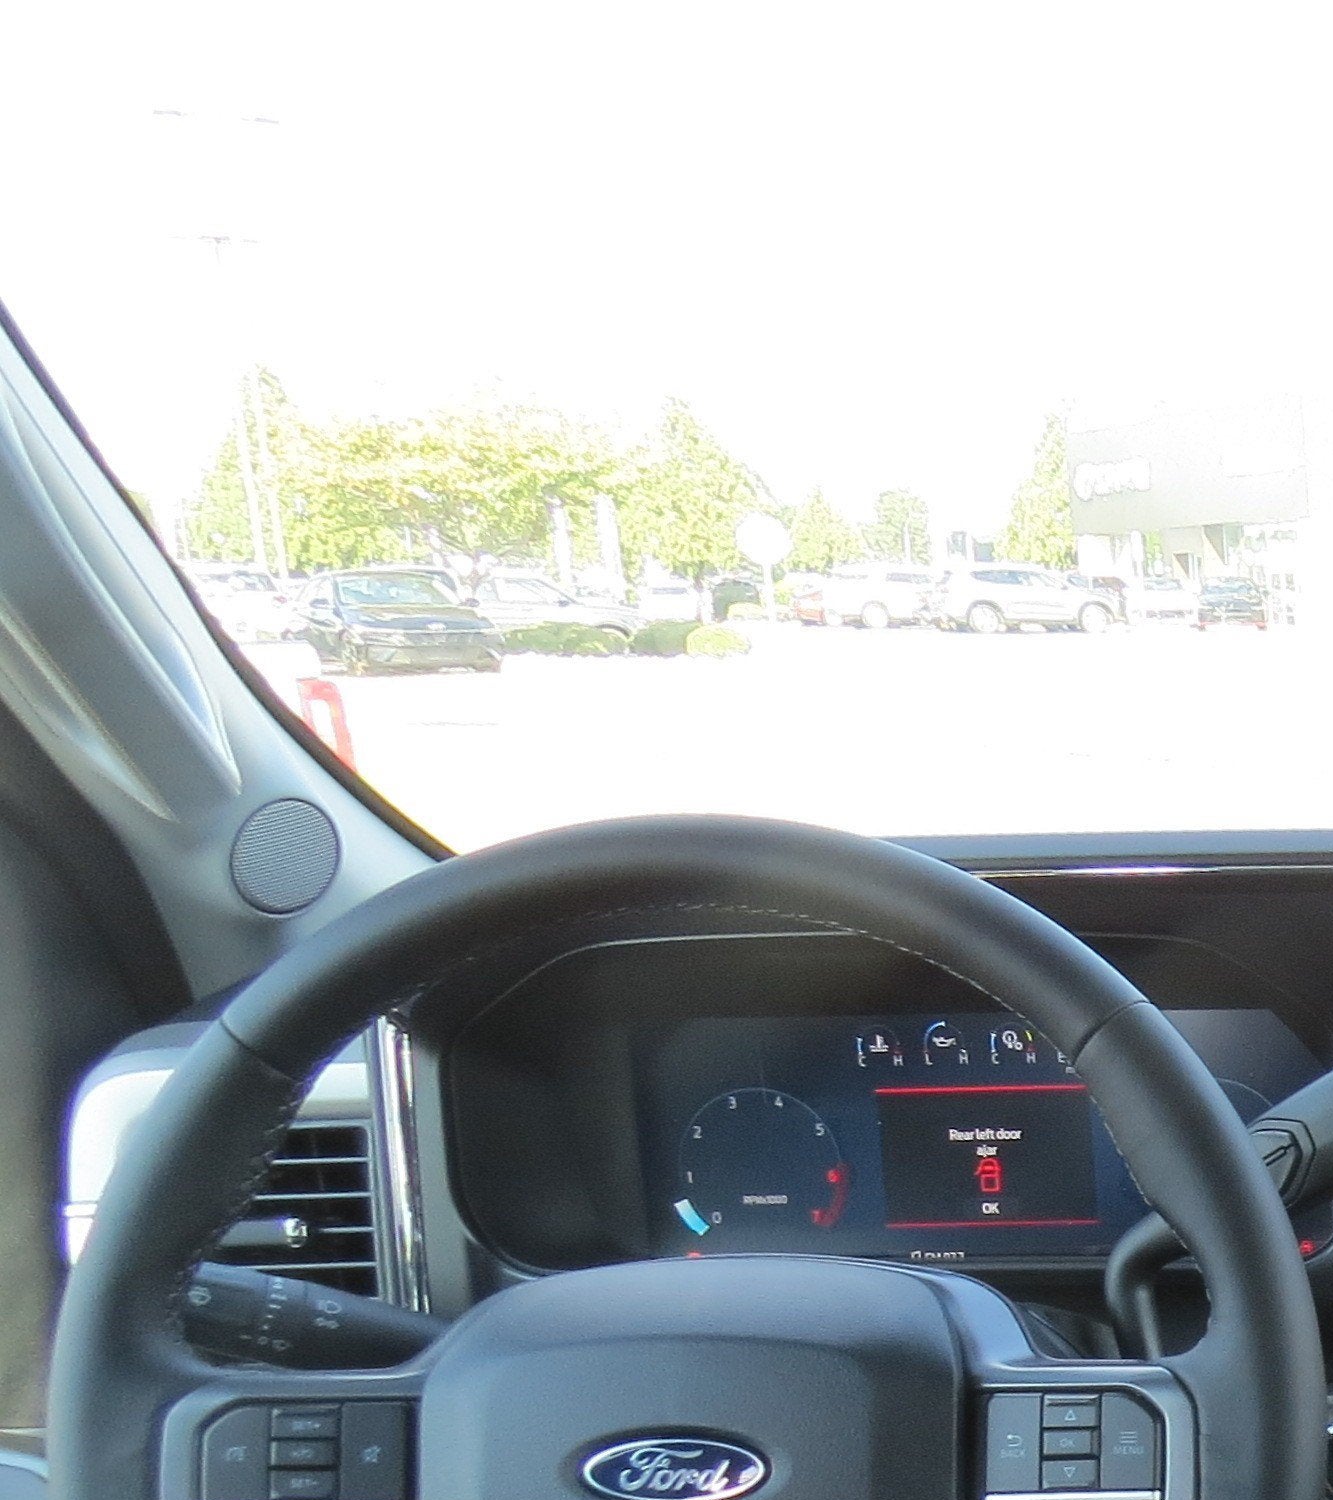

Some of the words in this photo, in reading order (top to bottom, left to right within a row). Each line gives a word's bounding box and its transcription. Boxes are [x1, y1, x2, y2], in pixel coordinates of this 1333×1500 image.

[728, 1096, 737, 1109] 3
[774, 1096, 783, 1108] 4
[693, 1126, 702, 1138] 2
[815, 1123, 825, 1136] 5
[948, 1129, 974, 1141] Rear
[975, 1128, 995, 1140] left
[996, 1128, 1022, 1140] door
[976, 1145, 998, 1157] ajar
[981, 1202, 1000, 1215] OK
[711, 1211, 722, 1224] 0
[1113, 1446, 1144, 1455] MENU
[619, 1447, 731, 1492] Ford
